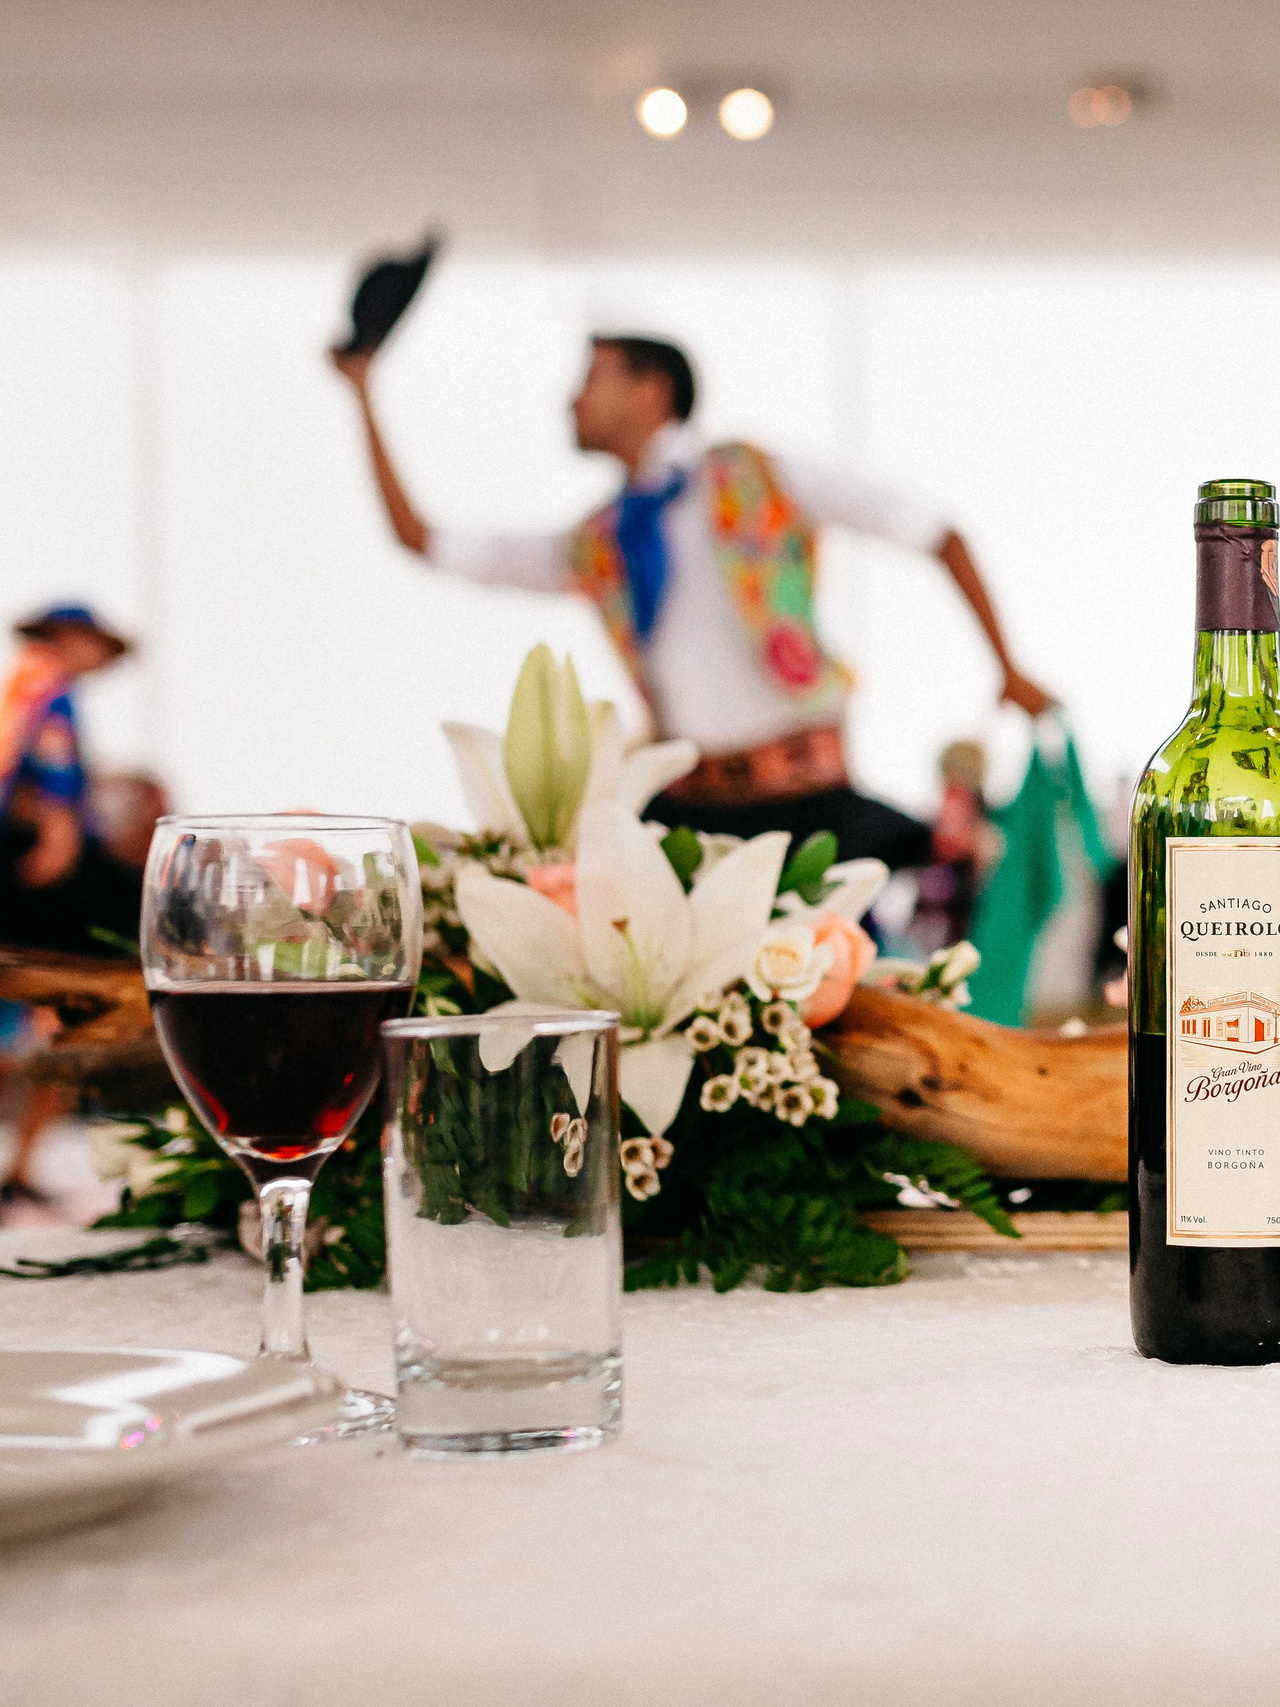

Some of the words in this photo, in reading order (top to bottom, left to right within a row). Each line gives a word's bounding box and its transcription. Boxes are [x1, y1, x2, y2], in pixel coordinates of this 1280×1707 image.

[1200, 898, 1272, 914] SANTIAGO
[1211, 1067, 1238, 1082] Gran
[1238, 1061, 1262, 1074] Vino
[1207, 1160, 1265, 1169] BORGOÑA
[1180, 1215, 1192, 1223] 11%
[1193, 1215, 1208, 1224] Vol.
